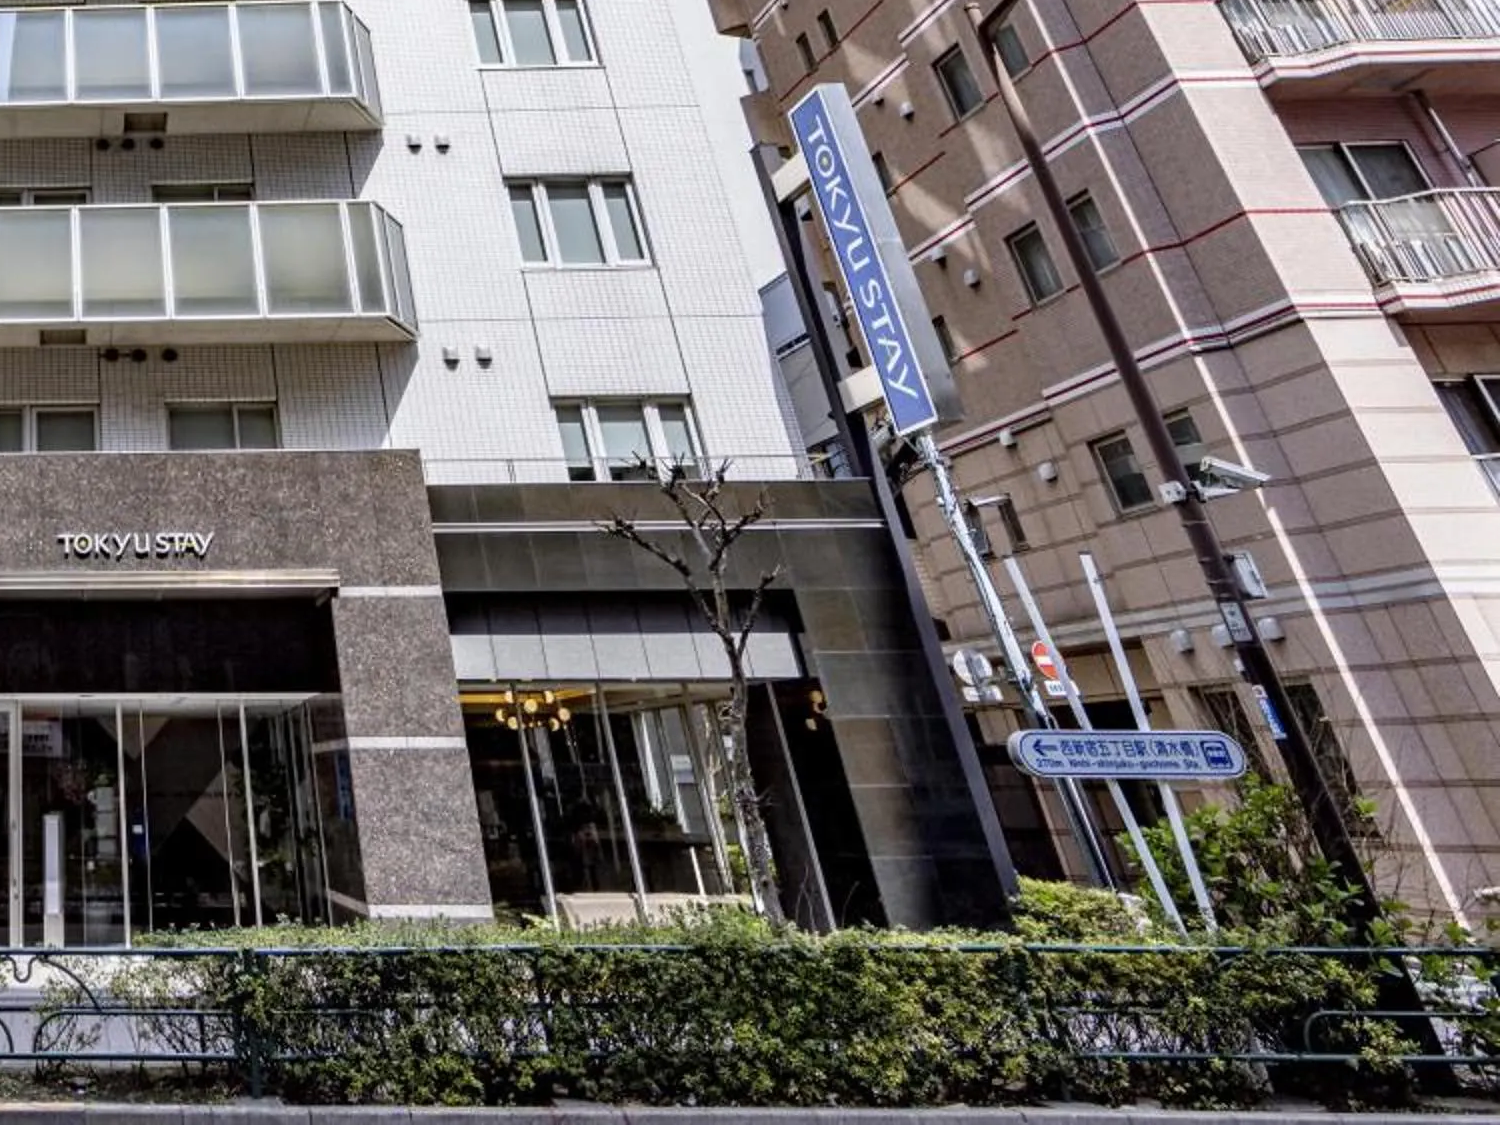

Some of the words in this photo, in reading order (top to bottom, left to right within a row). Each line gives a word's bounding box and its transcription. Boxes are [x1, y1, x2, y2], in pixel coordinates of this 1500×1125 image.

[807, 114, 870, 272] TOKYU
[859, 278, 919, 398] STAY
[56, 532, 150, 557] TOKYU
[155, 531, 214, 555] STAY
